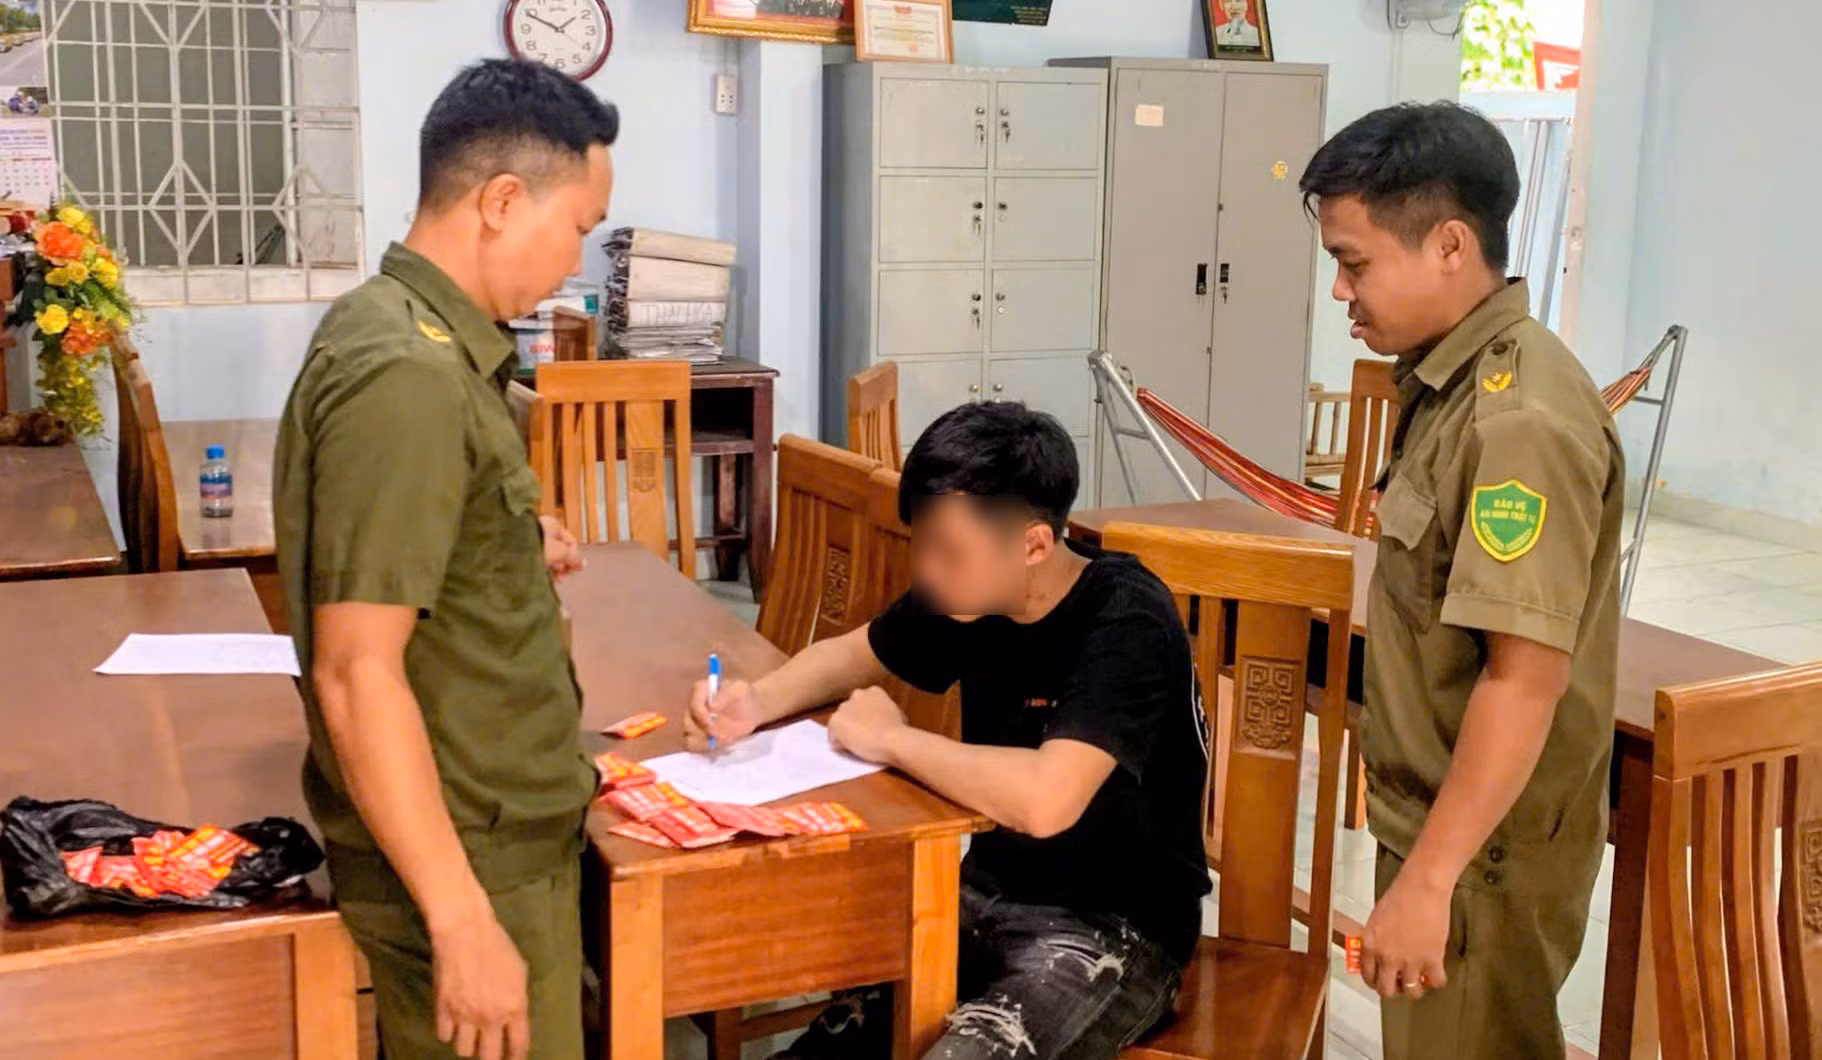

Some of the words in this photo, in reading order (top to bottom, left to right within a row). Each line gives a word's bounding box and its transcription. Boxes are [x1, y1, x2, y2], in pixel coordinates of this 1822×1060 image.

[581, 9, 591, 20] 2
[521, 23, 531, 35] 9
[585, 25, 596, 36] 3
[526, 40, 537, 51] 8
[581, 41, 591, 51] 4
[555, 58, 566, 69] 6
[572, 53, 582, 64] 5
